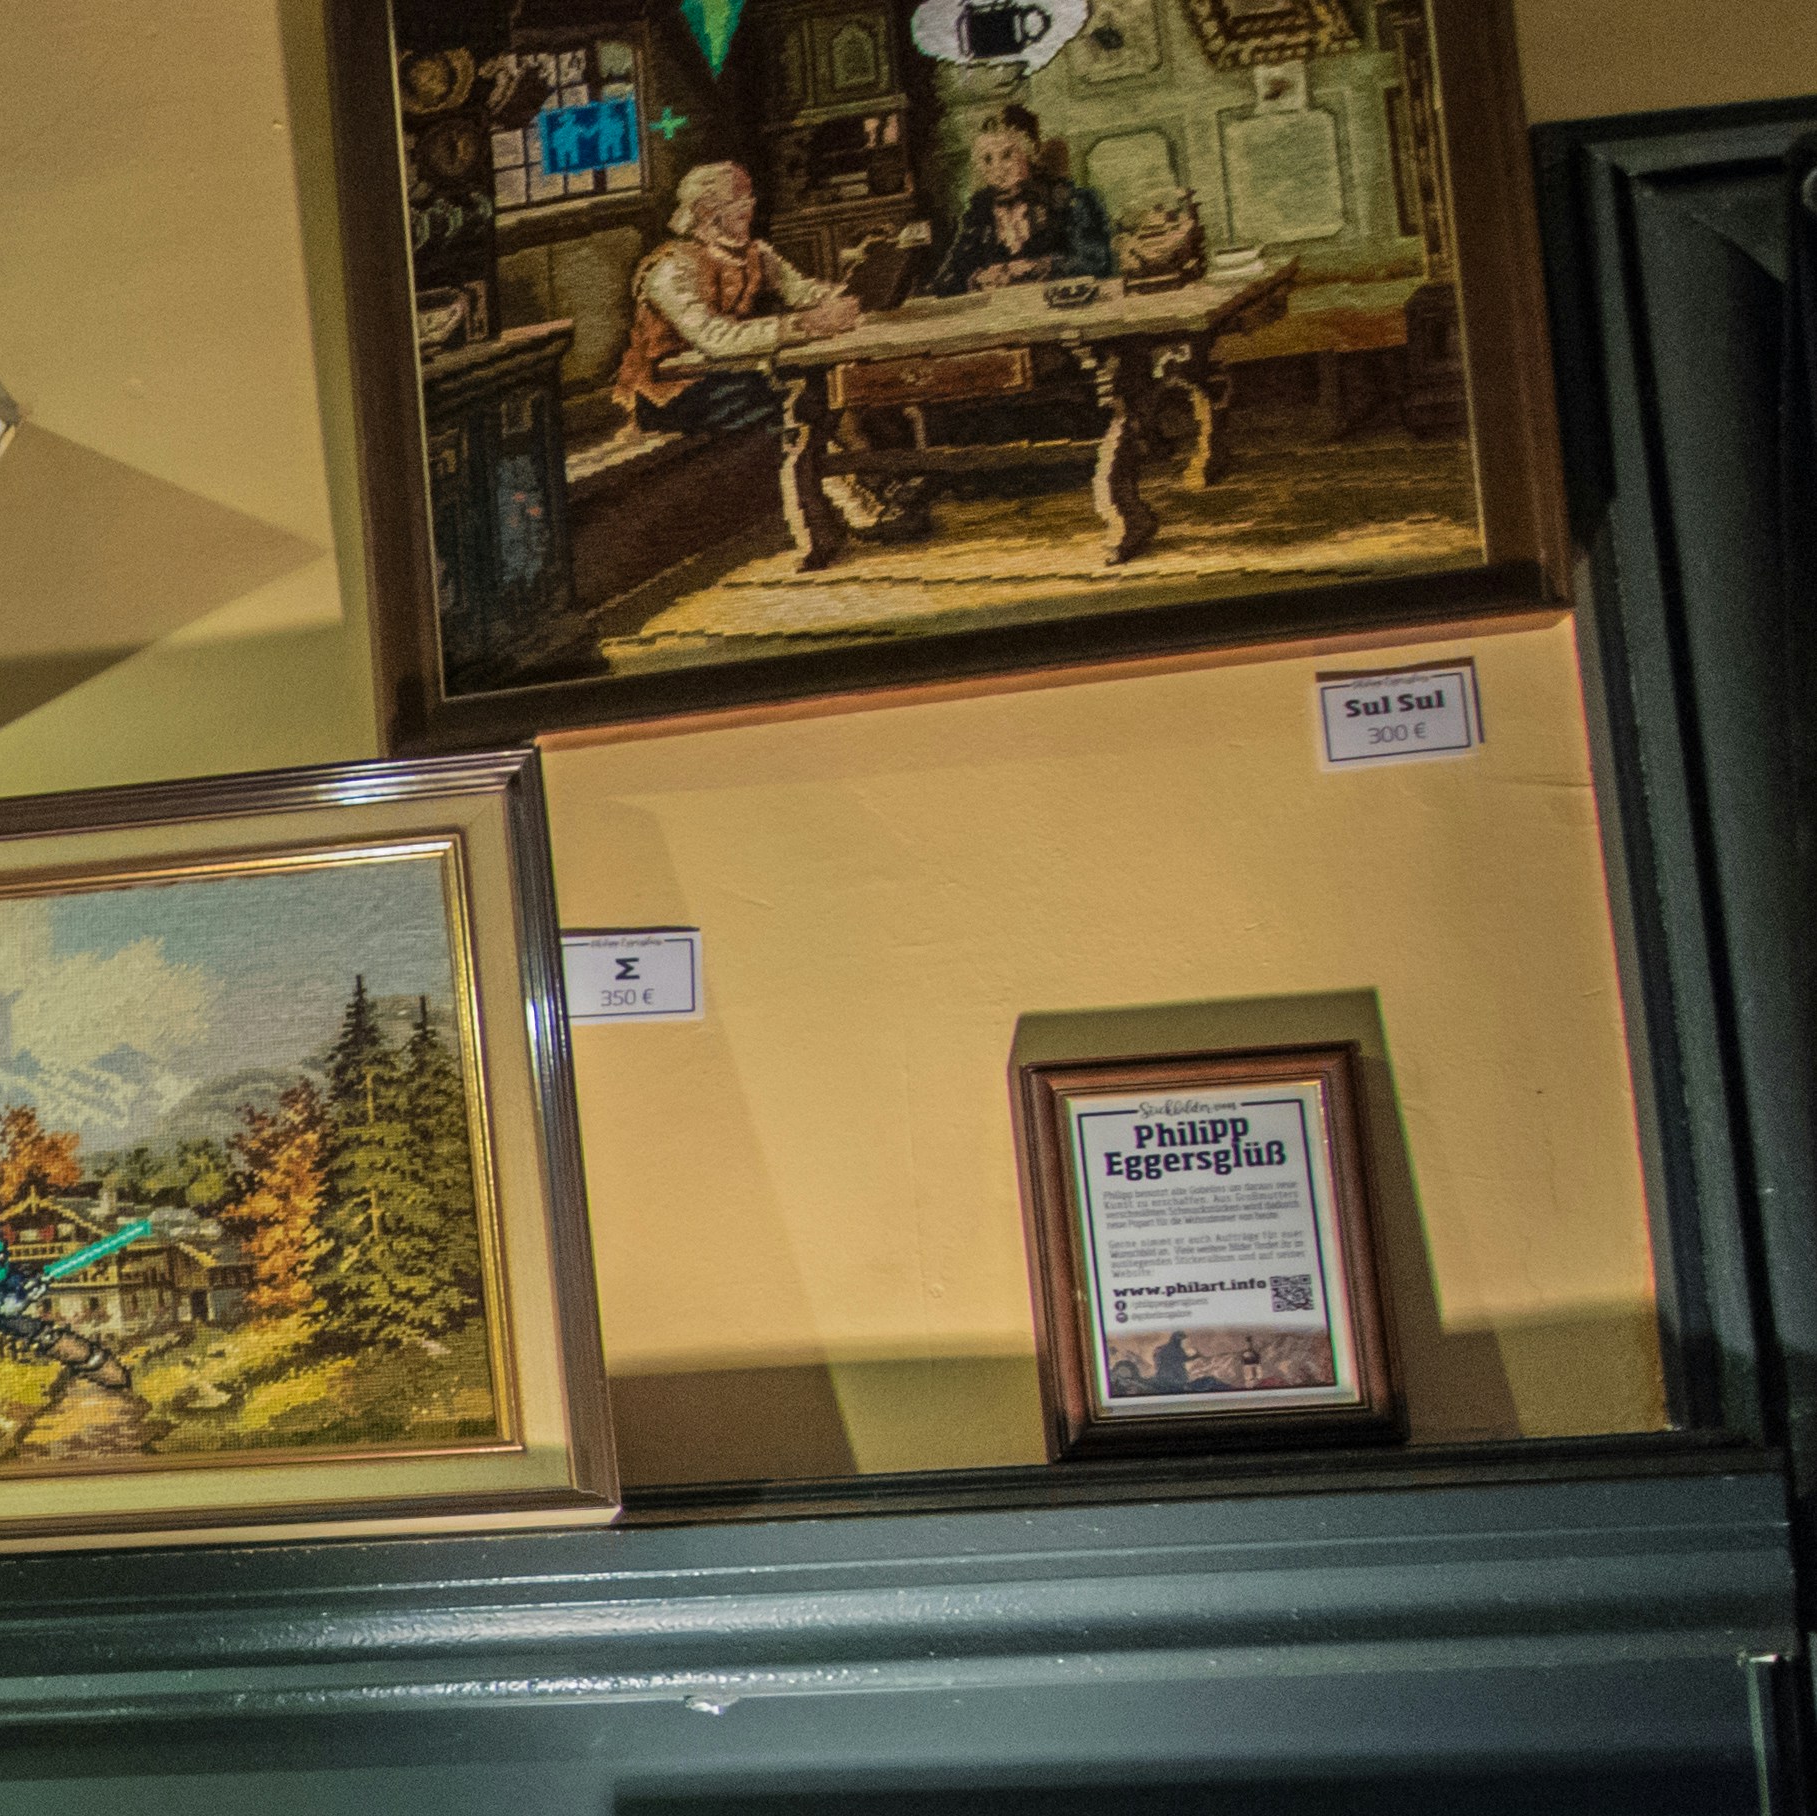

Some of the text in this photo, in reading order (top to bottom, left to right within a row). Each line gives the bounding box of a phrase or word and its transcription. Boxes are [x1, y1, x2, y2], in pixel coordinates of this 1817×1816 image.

[1344, 690, 1446, 718] Sul Sul
[1368, 721, 1427, 745] 300 €
[600, 988, 655, 1007] 350 €
[1133, 1117, 1249, 1149] Philipp
[1104, 1140, 1287, 1181] Eggersglüß
[1113, 1278, 1266, 1297] www.philart.info
